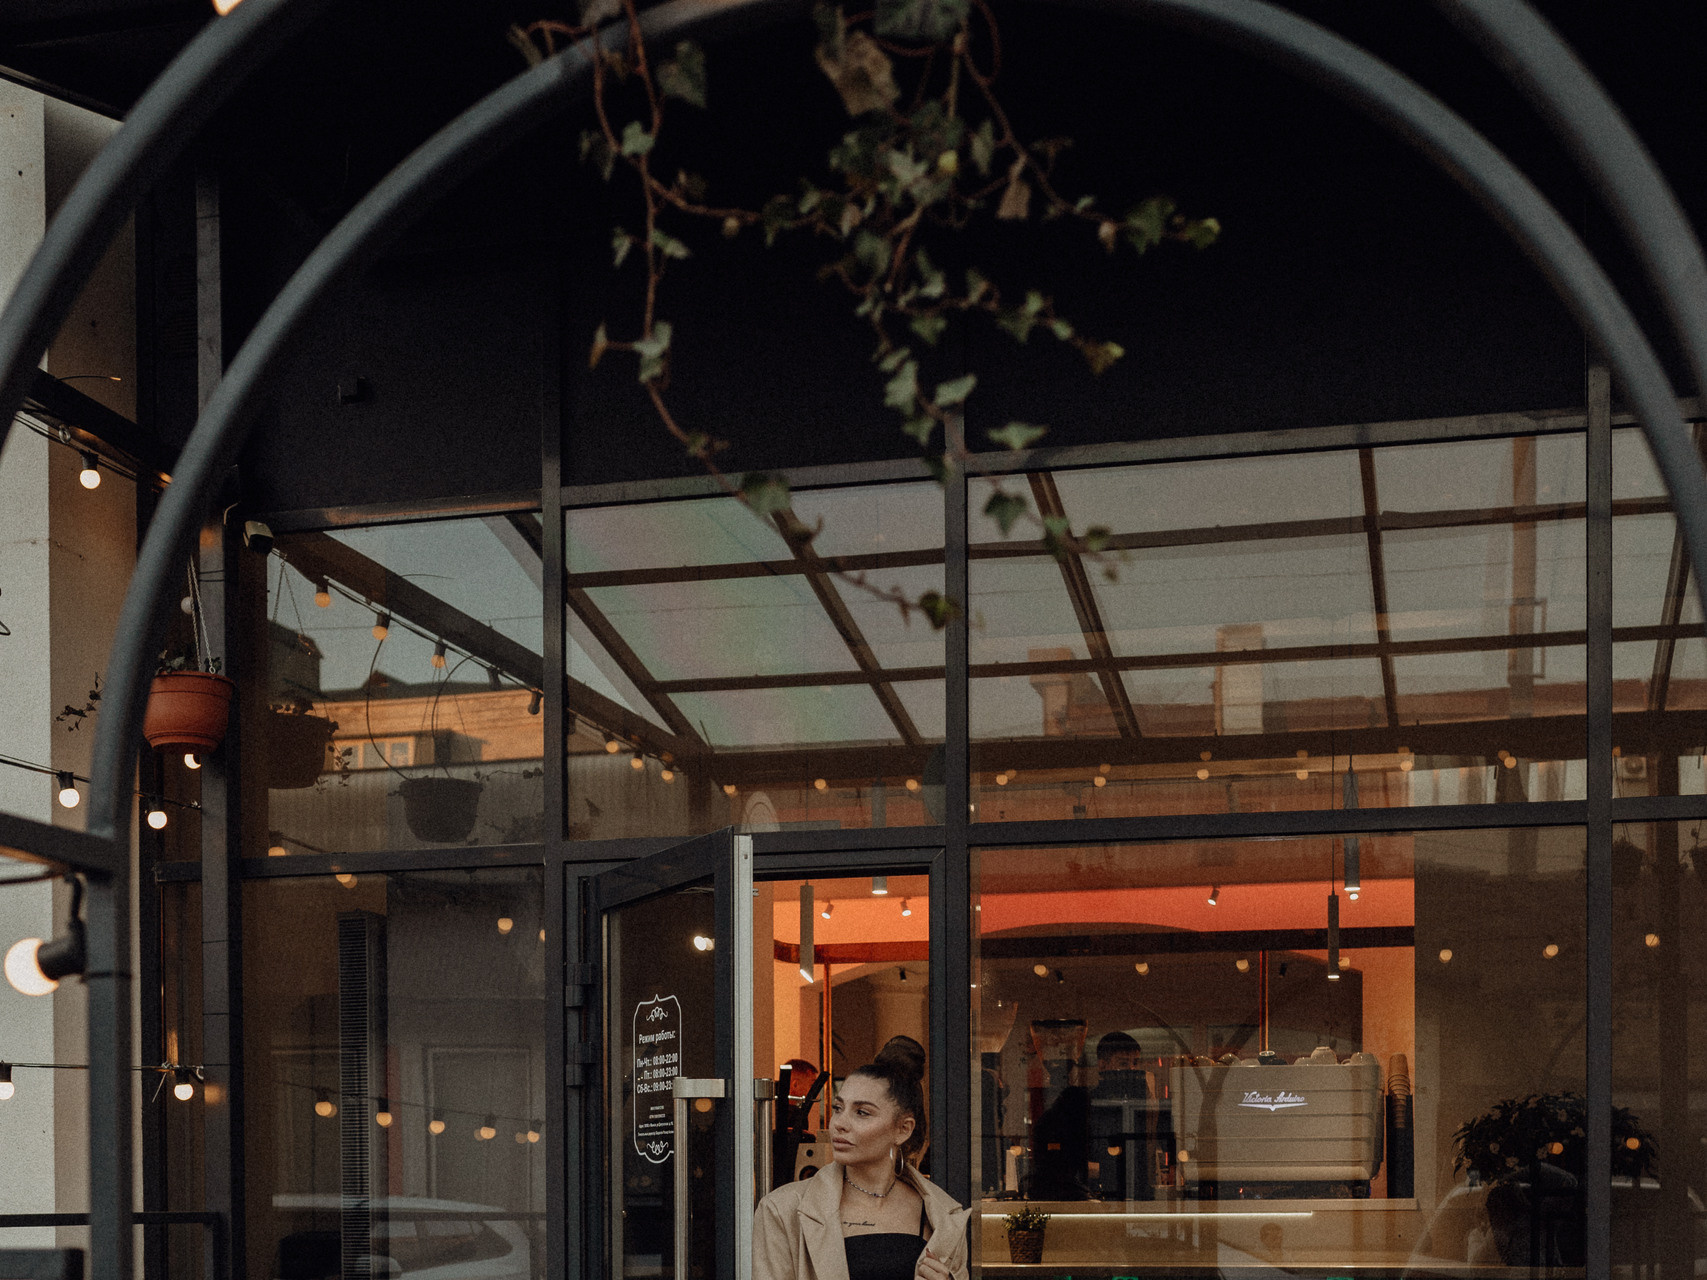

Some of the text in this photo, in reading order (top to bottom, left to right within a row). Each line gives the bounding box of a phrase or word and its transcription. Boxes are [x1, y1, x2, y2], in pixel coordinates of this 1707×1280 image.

[639, 1030, 676, 1044] Режим работы:
[653, 1080, 673, 1091] 09:00-23:
[1242, 1091, 1305, 1103] Victoria Arduino
